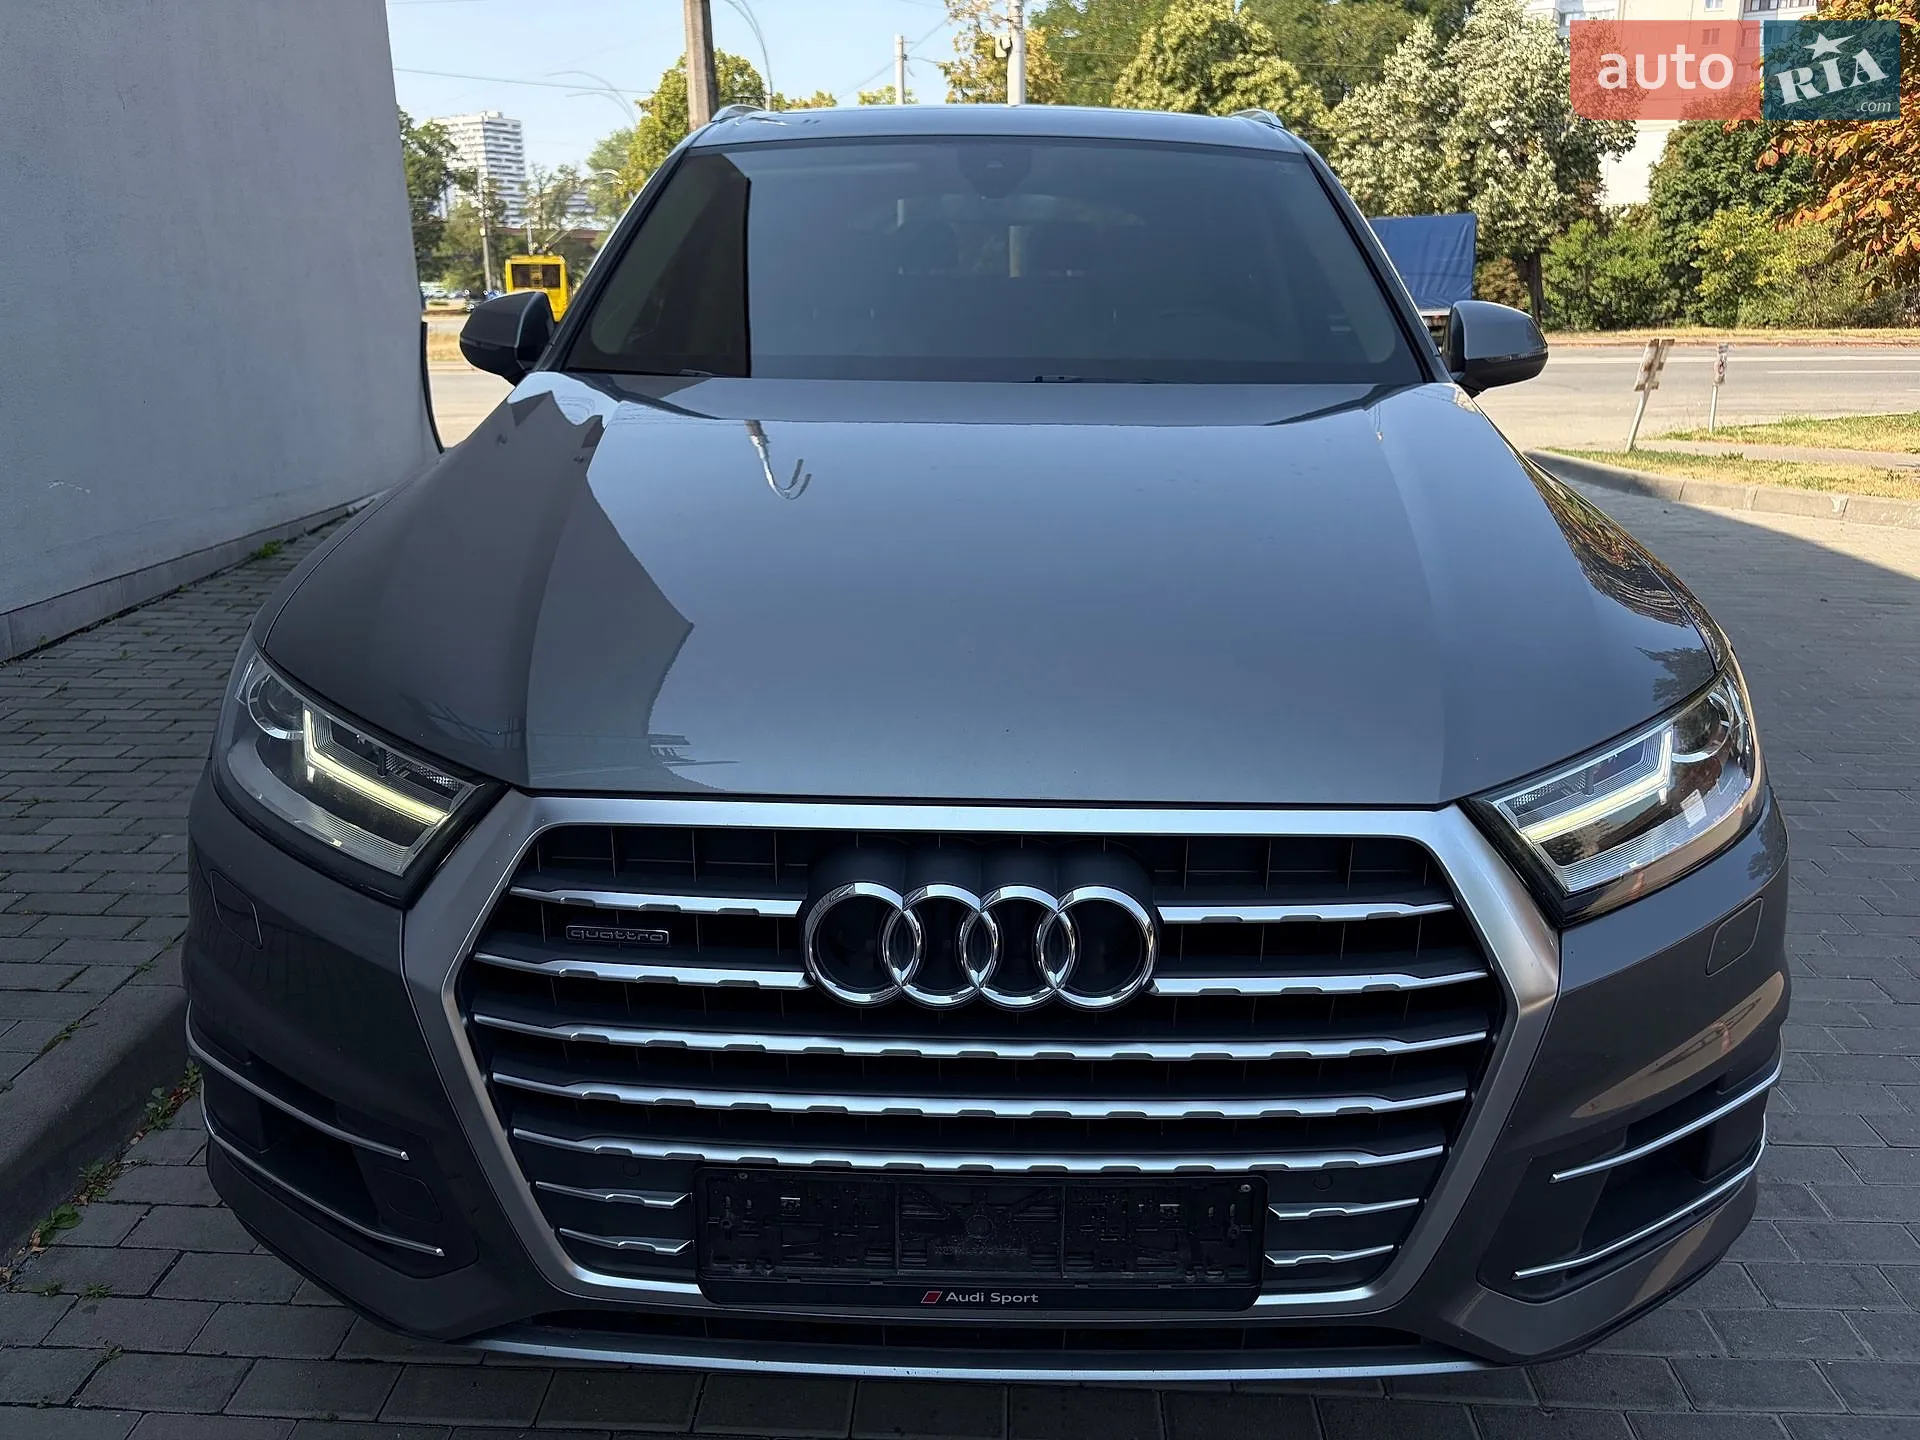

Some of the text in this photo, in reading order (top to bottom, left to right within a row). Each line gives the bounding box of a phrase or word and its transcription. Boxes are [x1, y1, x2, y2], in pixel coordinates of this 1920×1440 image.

[570, 929, 664, 941] quattro
[945, 1291, 1039, 1305] Audi Sport
